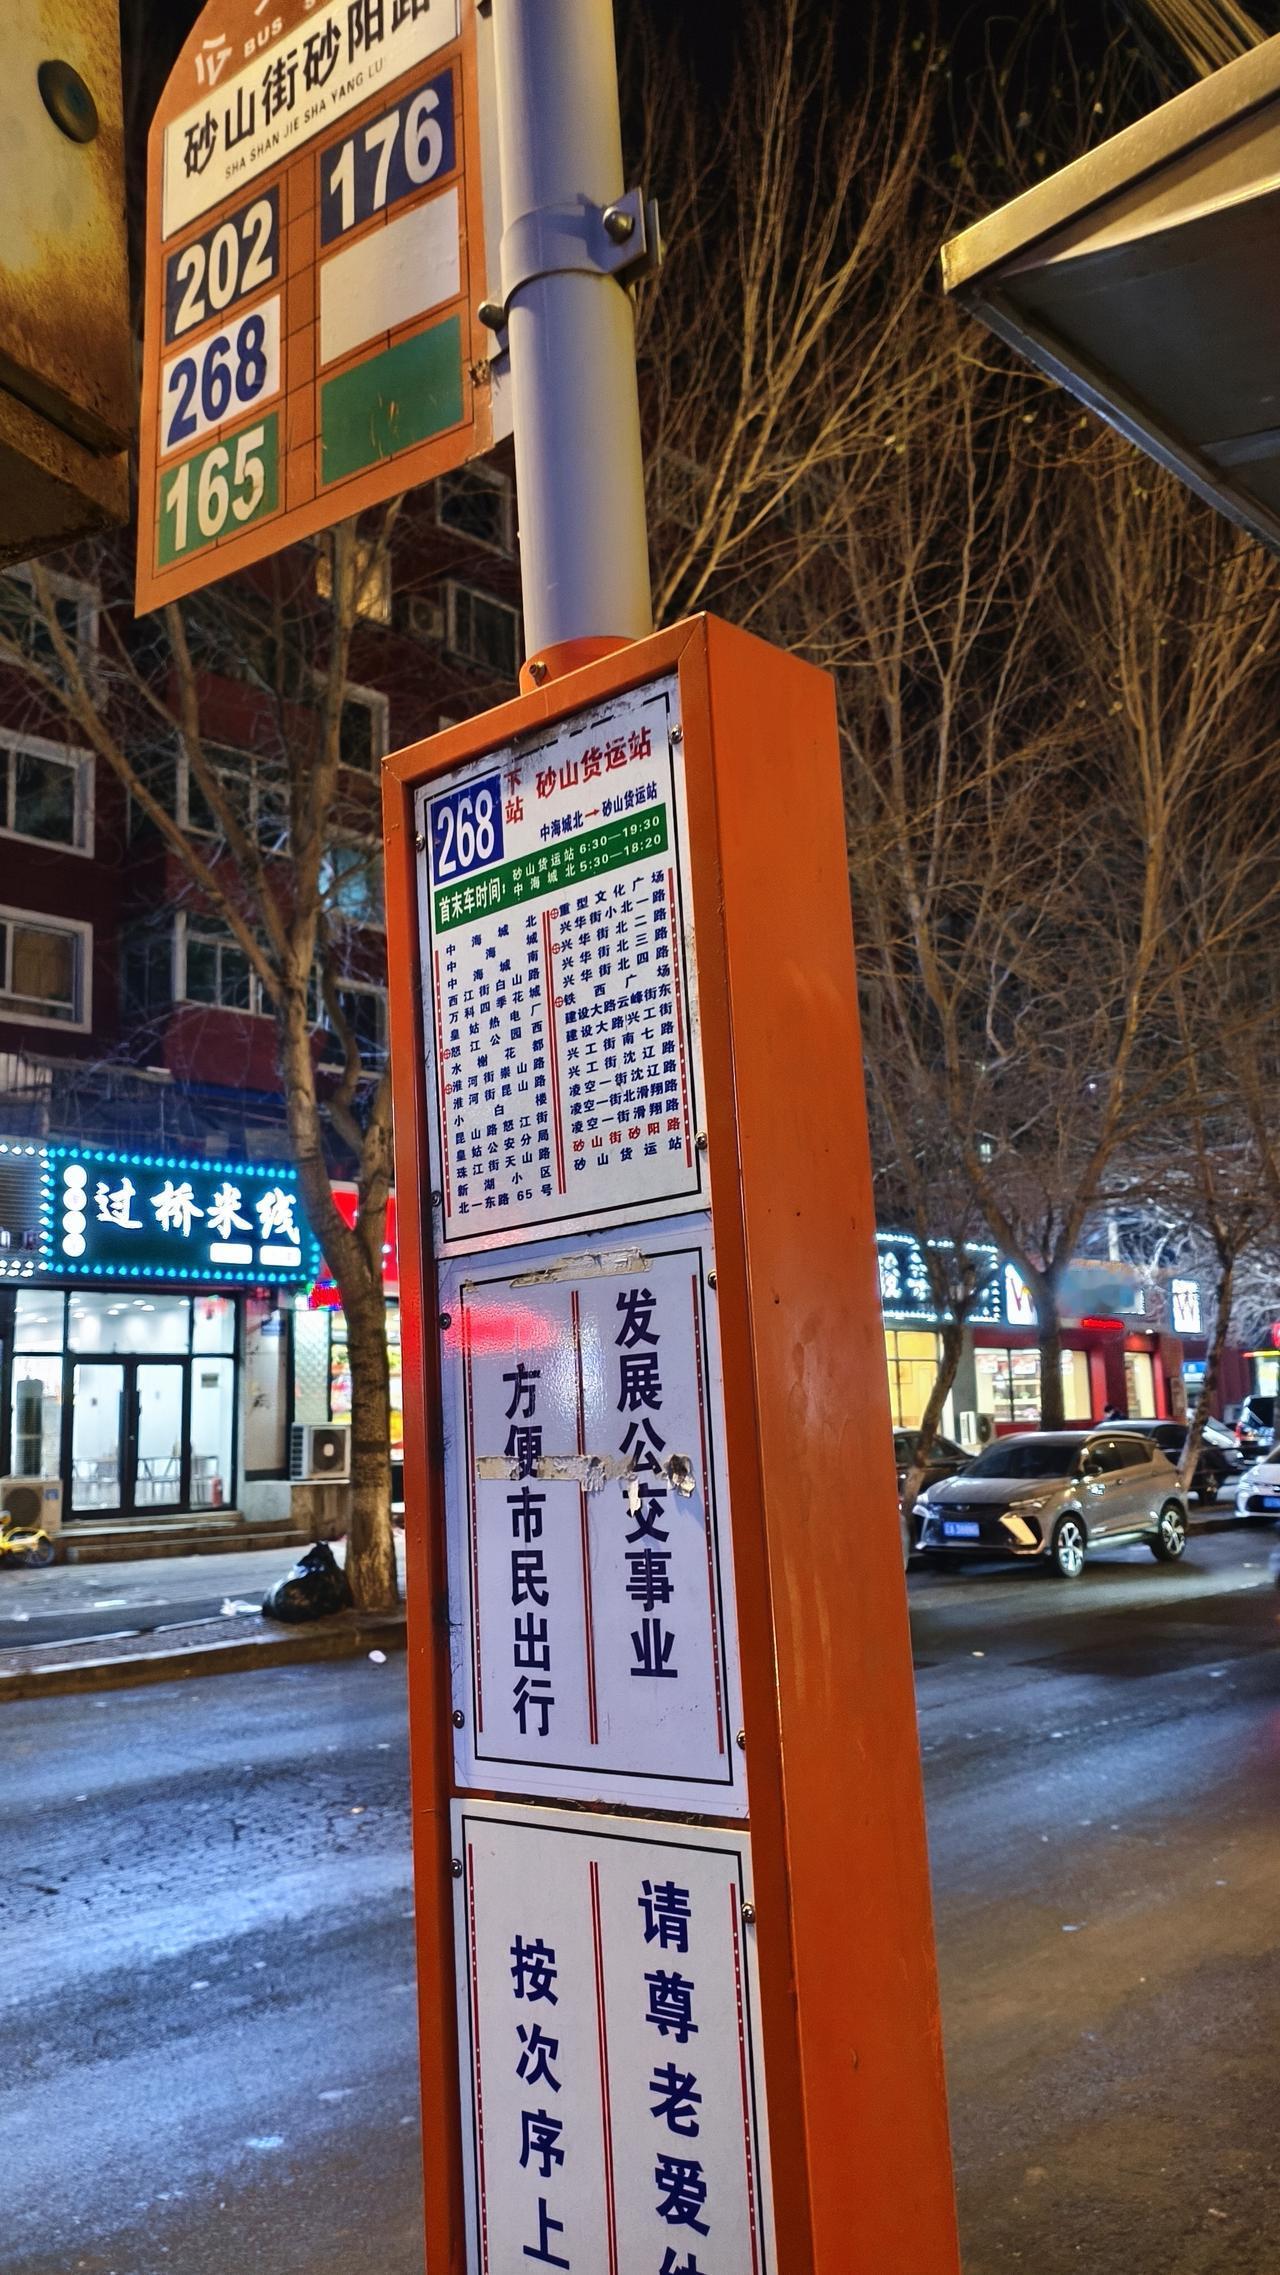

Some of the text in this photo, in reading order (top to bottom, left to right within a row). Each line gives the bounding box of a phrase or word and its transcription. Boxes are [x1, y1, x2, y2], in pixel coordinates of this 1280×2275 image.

[244, 16, 282, 58] BUS
[225, 58, 383, 180] SHA SHAN JIE SHA YANG LU
[329, 88, 443, 231] 176
[172, 199, 274, 336] 202
[166, 313, 266, 447] 268
[165, 424, 265, 553] 165
[536, 726, 652, 799] 砂山货运站
[437, 789, 495, 877] 268
[512, 848, 575, 881] 砂山货运站
[514, 862, 575, 896] 中海城北
[559, 870, 664, 917] 重型文化广场
[559, 889, 666, 935] 兴华街小北一路
[561, 907, 667, 953] 兴华街北二路
[562, 926, 668, 971] 兴华街北三路
[448, 968, 540, 1007] 西江街白山路
[563, 945, 670, 989] 兴华街北四路
[449, 985, 541, 1024] 万科四季花城
[450, 1003, 541, 1041] 皇姑热电厂
[566, 1002, 673, 1043] 建设大路兴工街
[450, 1021, 543, 1058] 怒江公园西
[567, 1021, 674, 1061] 兴工街南七路
[568, 1040, 676, 1079] 兴工街沈辽路
[456, 1129, 549, 1162] 皇姑公安分局
[572, 1117, 681, 1153] 砂山街砂阳路
[574, 1136, 682, 1172] 砂山货运站
[93, 1176, 301, 1245] 过桥米线
[615, 1288, 678, 1679] 发展公交事业
[502, 1362, 556, 1737] 方便市民出行
[510, 1934, 570, 2271] 按次序上
